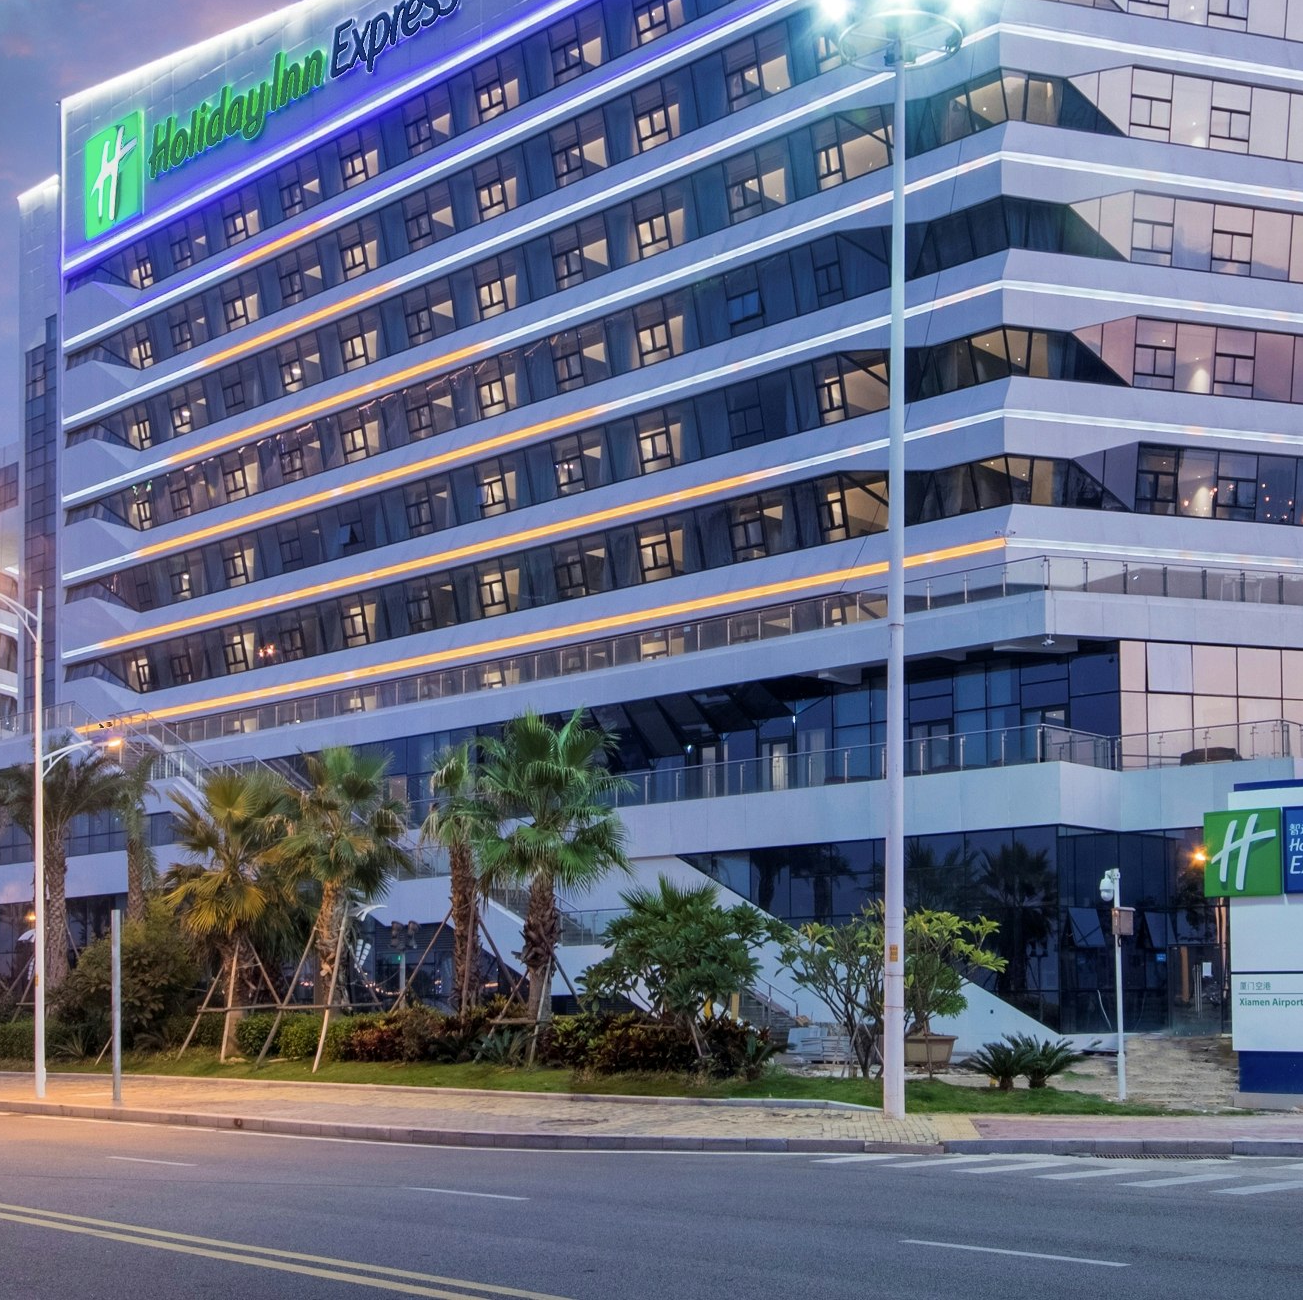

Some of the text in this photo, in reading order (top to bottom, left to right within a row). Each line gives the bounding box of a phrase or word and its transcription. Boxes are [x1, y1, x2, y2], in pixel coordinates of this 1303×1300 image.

[149, 81, 270, 178] Holiday
[269, 49, 327, 111] Inn
[1239, 981, 1271, 991] 厦门空港
[1239, 998, 1270, 1006] Xiamen
[1272, 998, 1303, 1008] Airport
